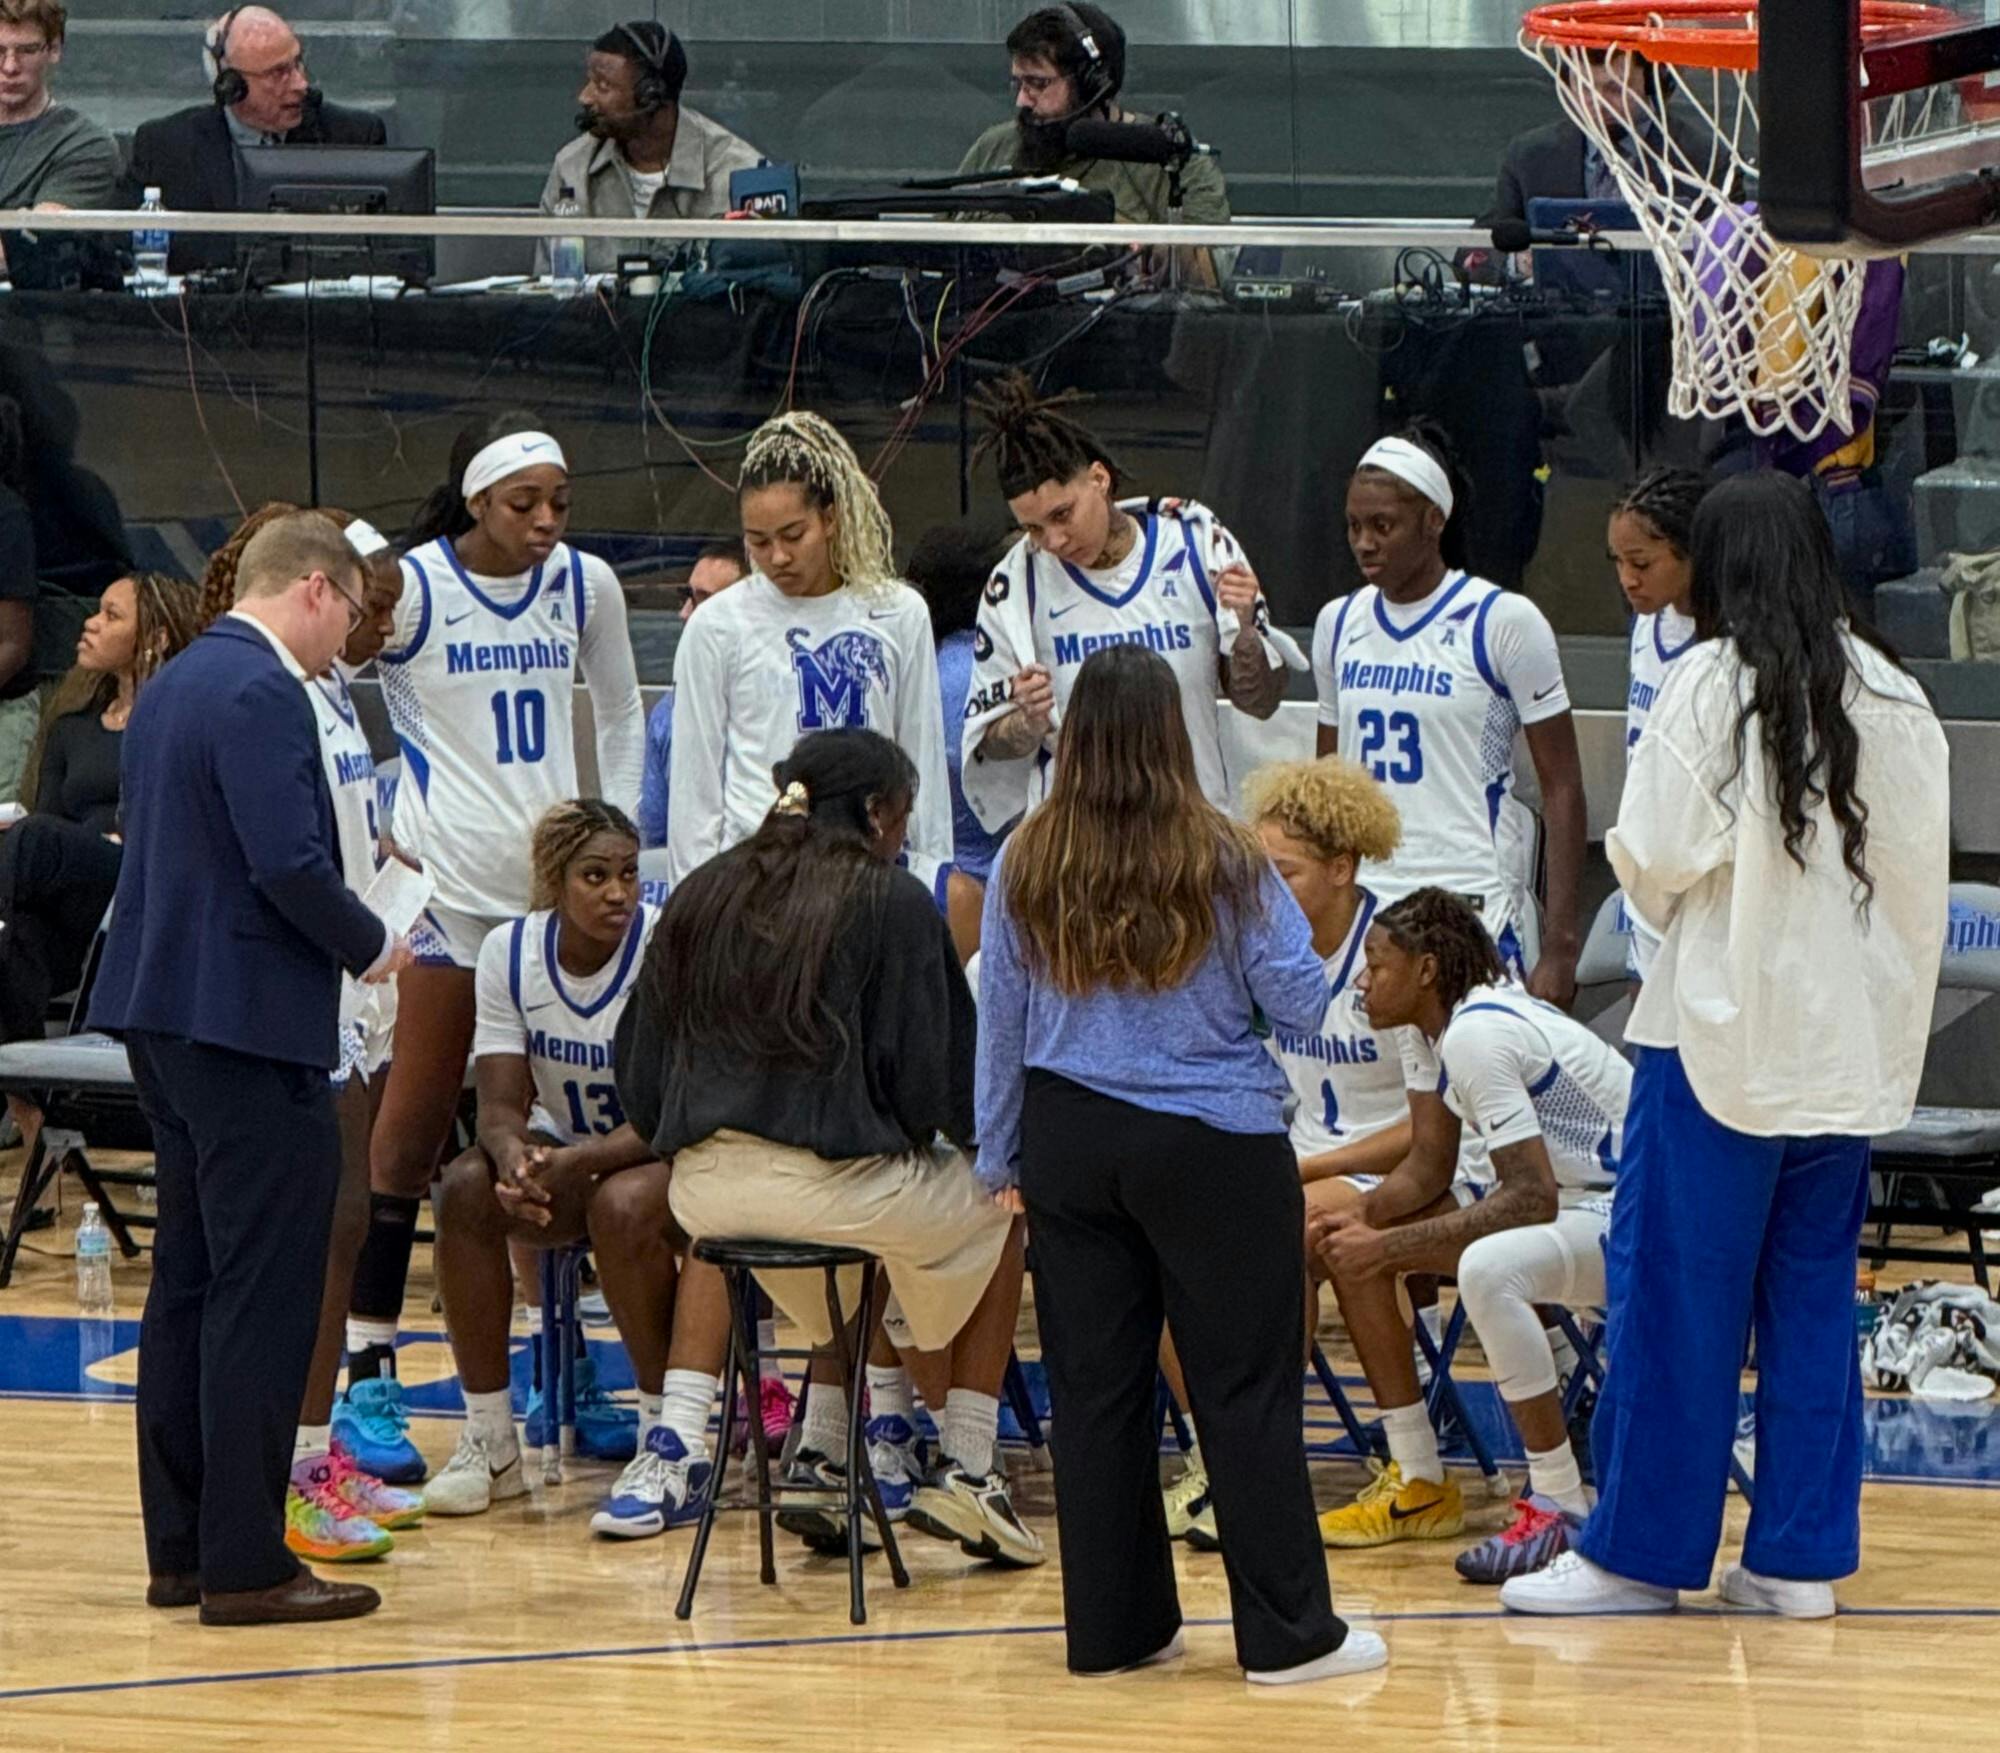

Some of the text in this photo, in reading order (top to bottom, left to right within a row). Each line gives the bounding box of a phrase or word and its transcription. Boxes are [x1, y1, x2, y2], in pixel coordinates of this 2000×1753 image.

[446, 637, 570, 675] Memphis
[1341, 660, 1454, 697] Memphis
[490, 689, 545, 764] 10
[1358, 709, 1424, 784] 23
[563, 1079, 626, 1136] 13
[1321, 1078, 1344, 1136] 1
